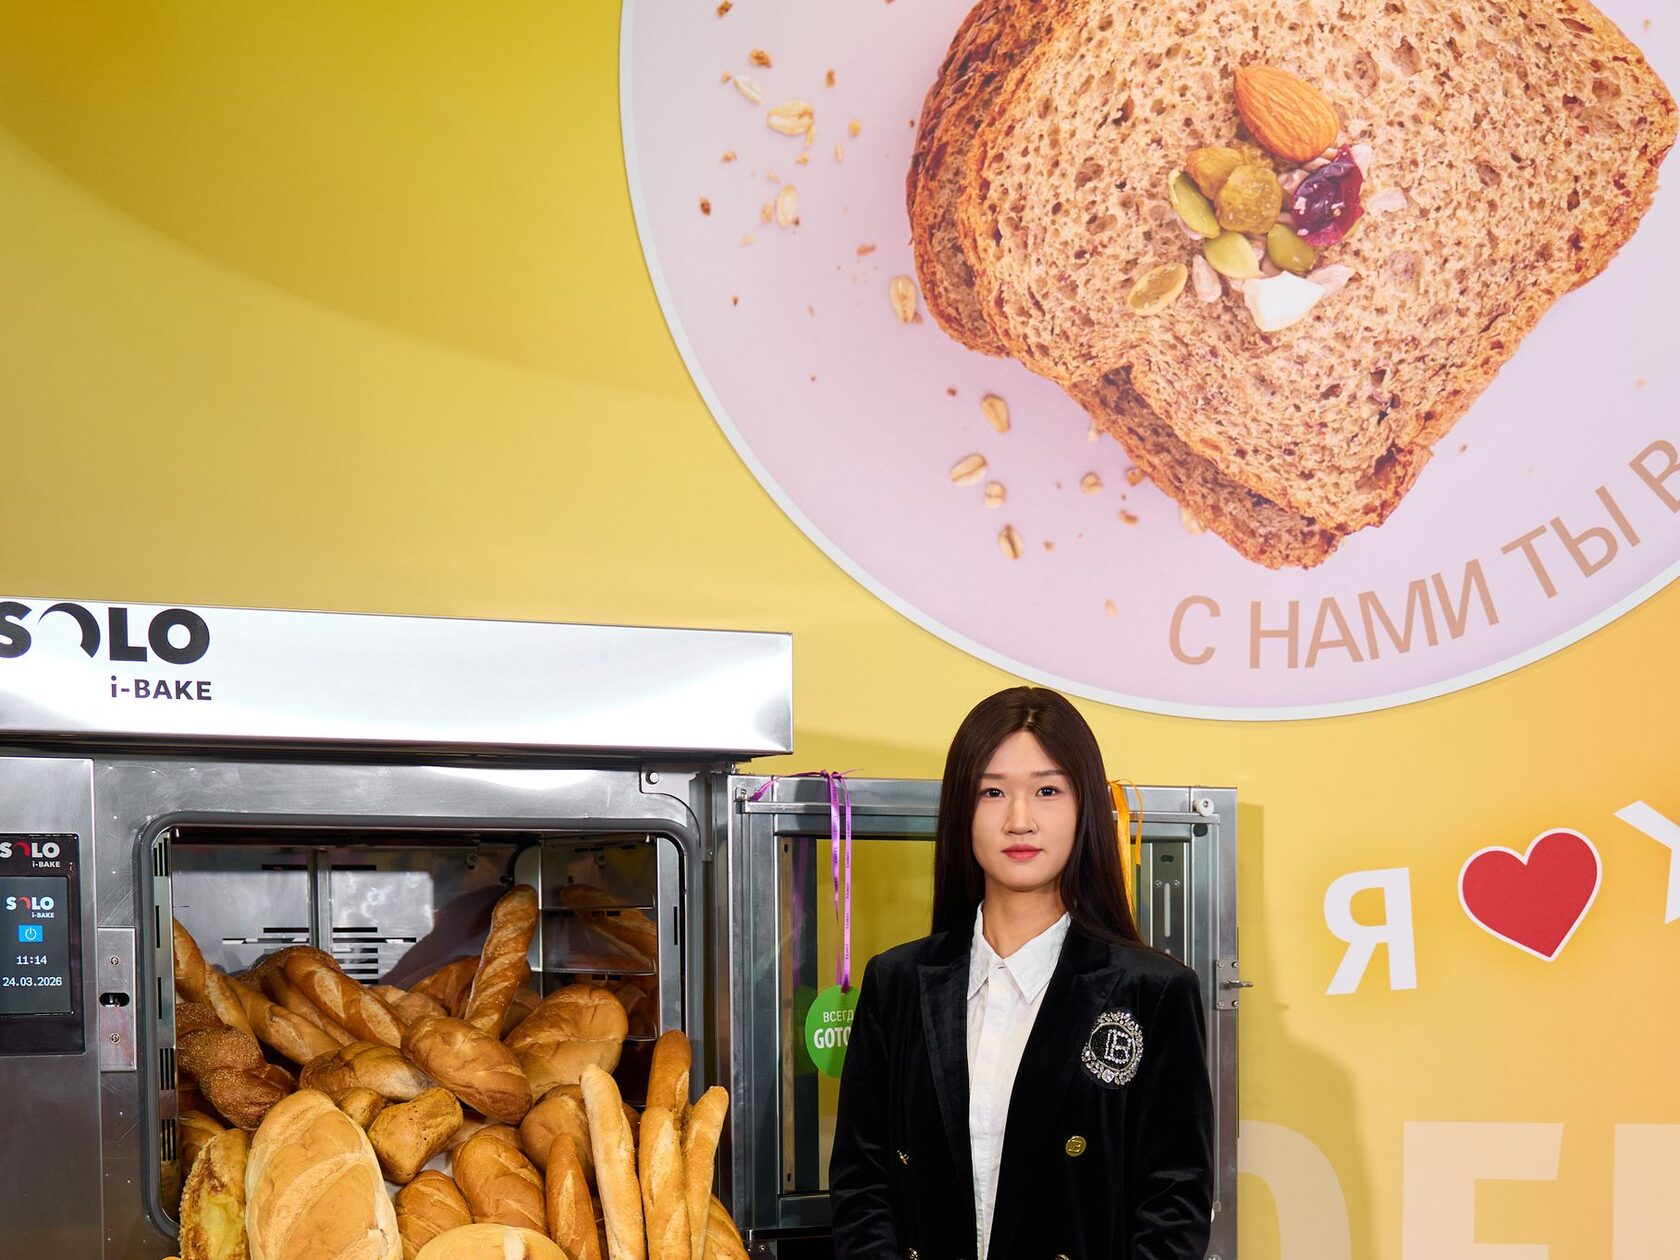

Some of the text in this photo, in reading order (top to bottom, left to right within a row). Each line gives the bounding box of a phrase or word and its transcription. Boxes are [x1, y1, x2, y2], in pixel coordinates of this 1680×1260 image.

[1169, 595, 1221, 665] С
[1249, 558, 1499, 669] НАМИ
[1500, 485, 1641, 599] ТЫ
[110, 676, 213, 701] i-BAKE
[32, 860, 61, 868] i-BAKE
[6, 896, 55, 911] SOLO
[31, 911, 55, 919] i-BAKE
[1323, 867, 1418, 995] Я
[16, 955, 47, 965] 11:14
[2, 976, 63, 987] 24.03.2026
